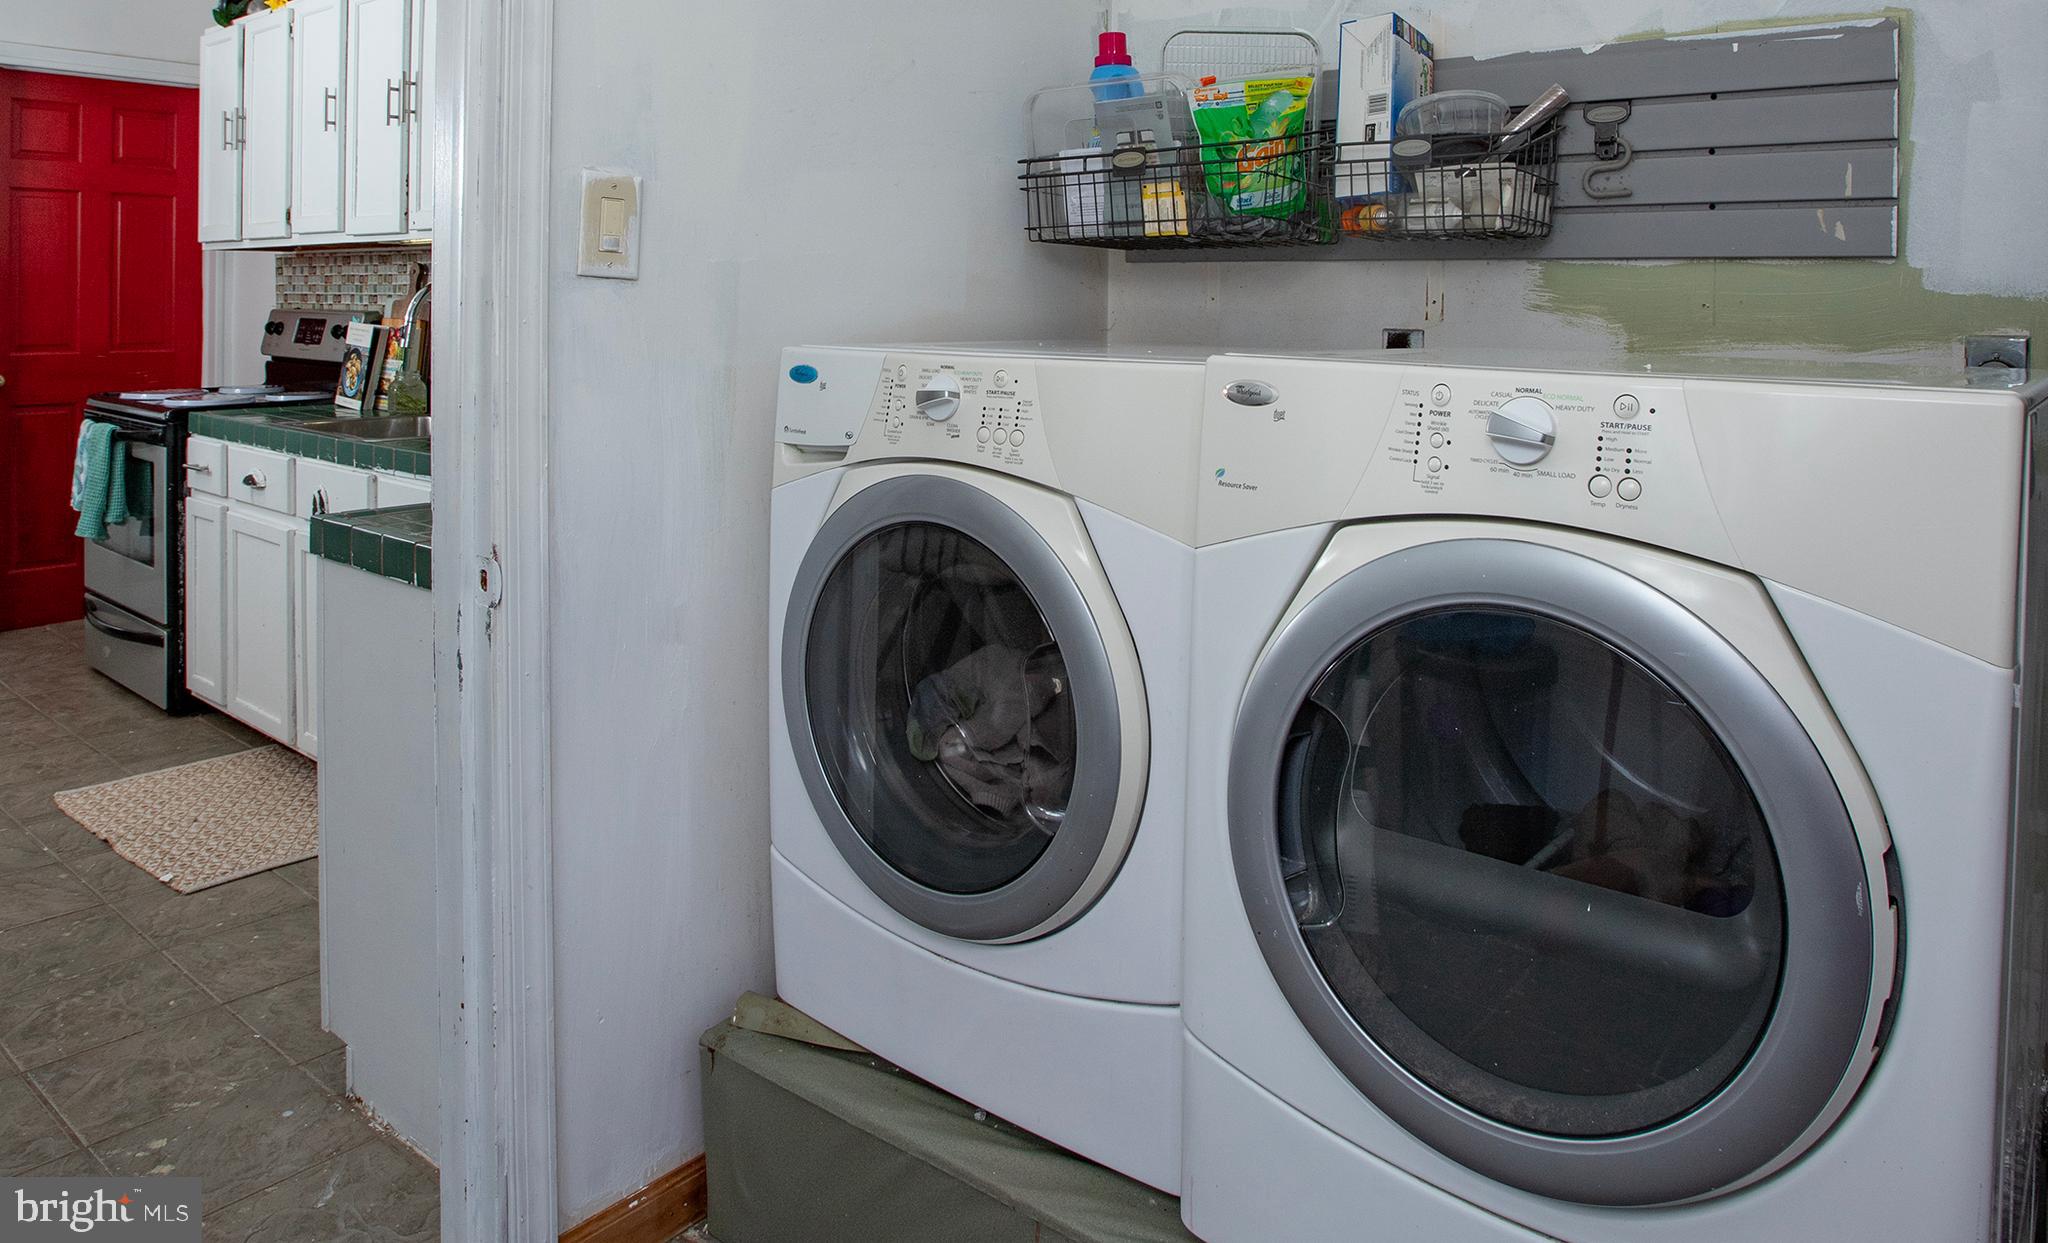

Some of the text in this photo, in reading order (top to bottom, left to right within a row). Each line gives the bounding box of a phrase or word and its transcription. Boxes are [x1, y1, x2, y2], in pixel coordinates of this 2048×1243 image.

[1402, 389, 1420, 397] STATUS
[1557, 394, 1584, 402] NORMAL
[1429, 409, 1451, 417] POWER
[1600, 422, 1652, 431] START/PAUSE
[1218, 480, 1258, 491] Resource Saver
[1590, 500, 1606, 508] Temp
[1615, 502, 1638, 510] Dryness
